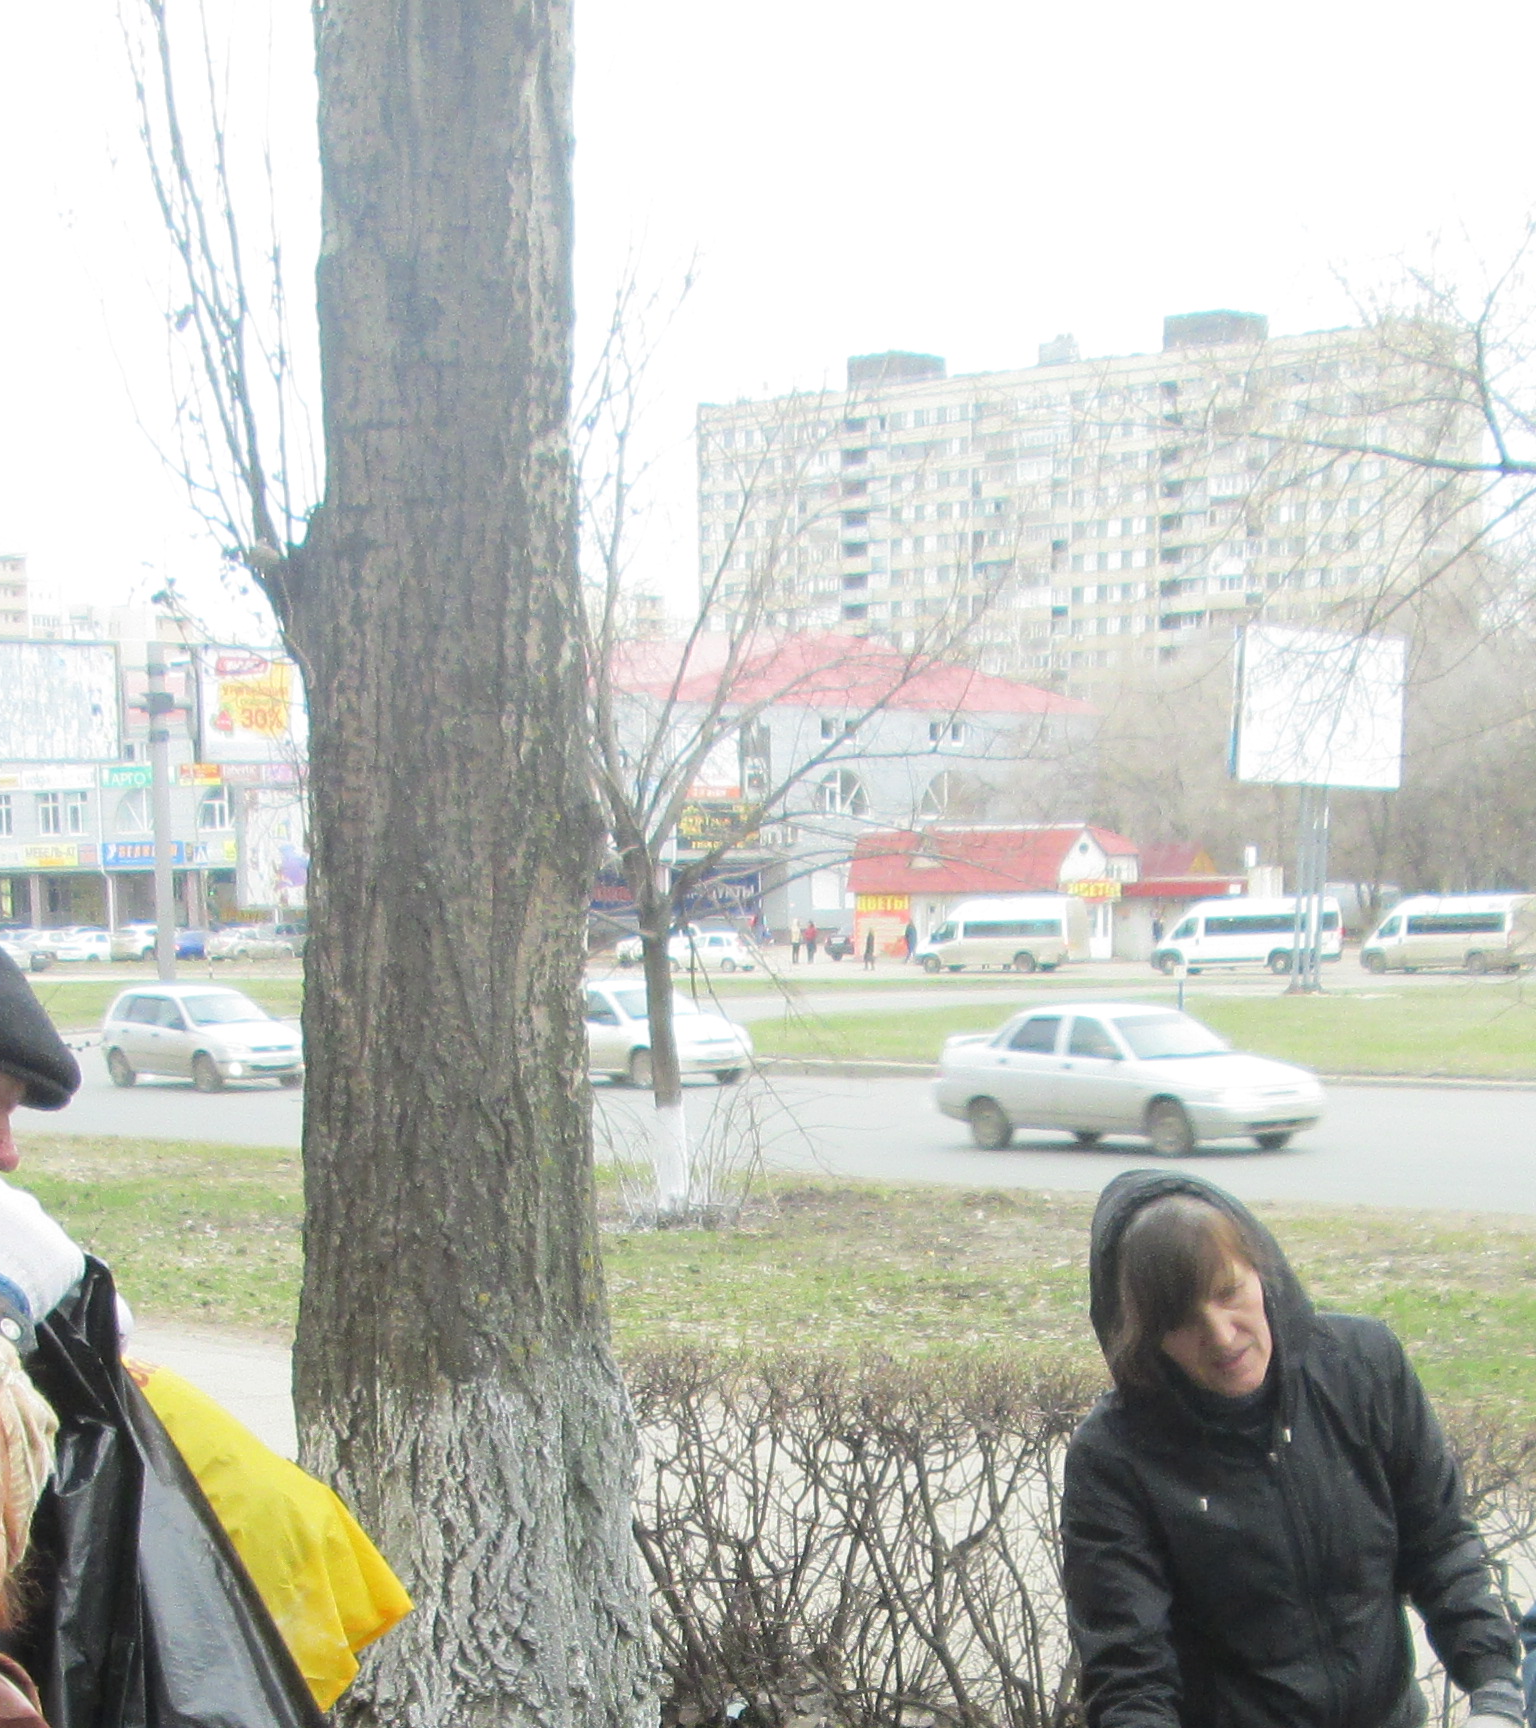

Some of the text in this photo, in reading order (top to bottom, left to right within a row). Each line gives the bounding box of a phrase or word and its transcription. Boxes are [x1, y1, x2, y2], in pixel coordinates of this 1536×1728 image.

[241, 708, 284, 730] 30%
[111, 772, 146, 786] АРГО
[1068, 882, 1122, 898] ЦВЕТЫ
[857, 895, 908, 911] ЦВЕТЫ
